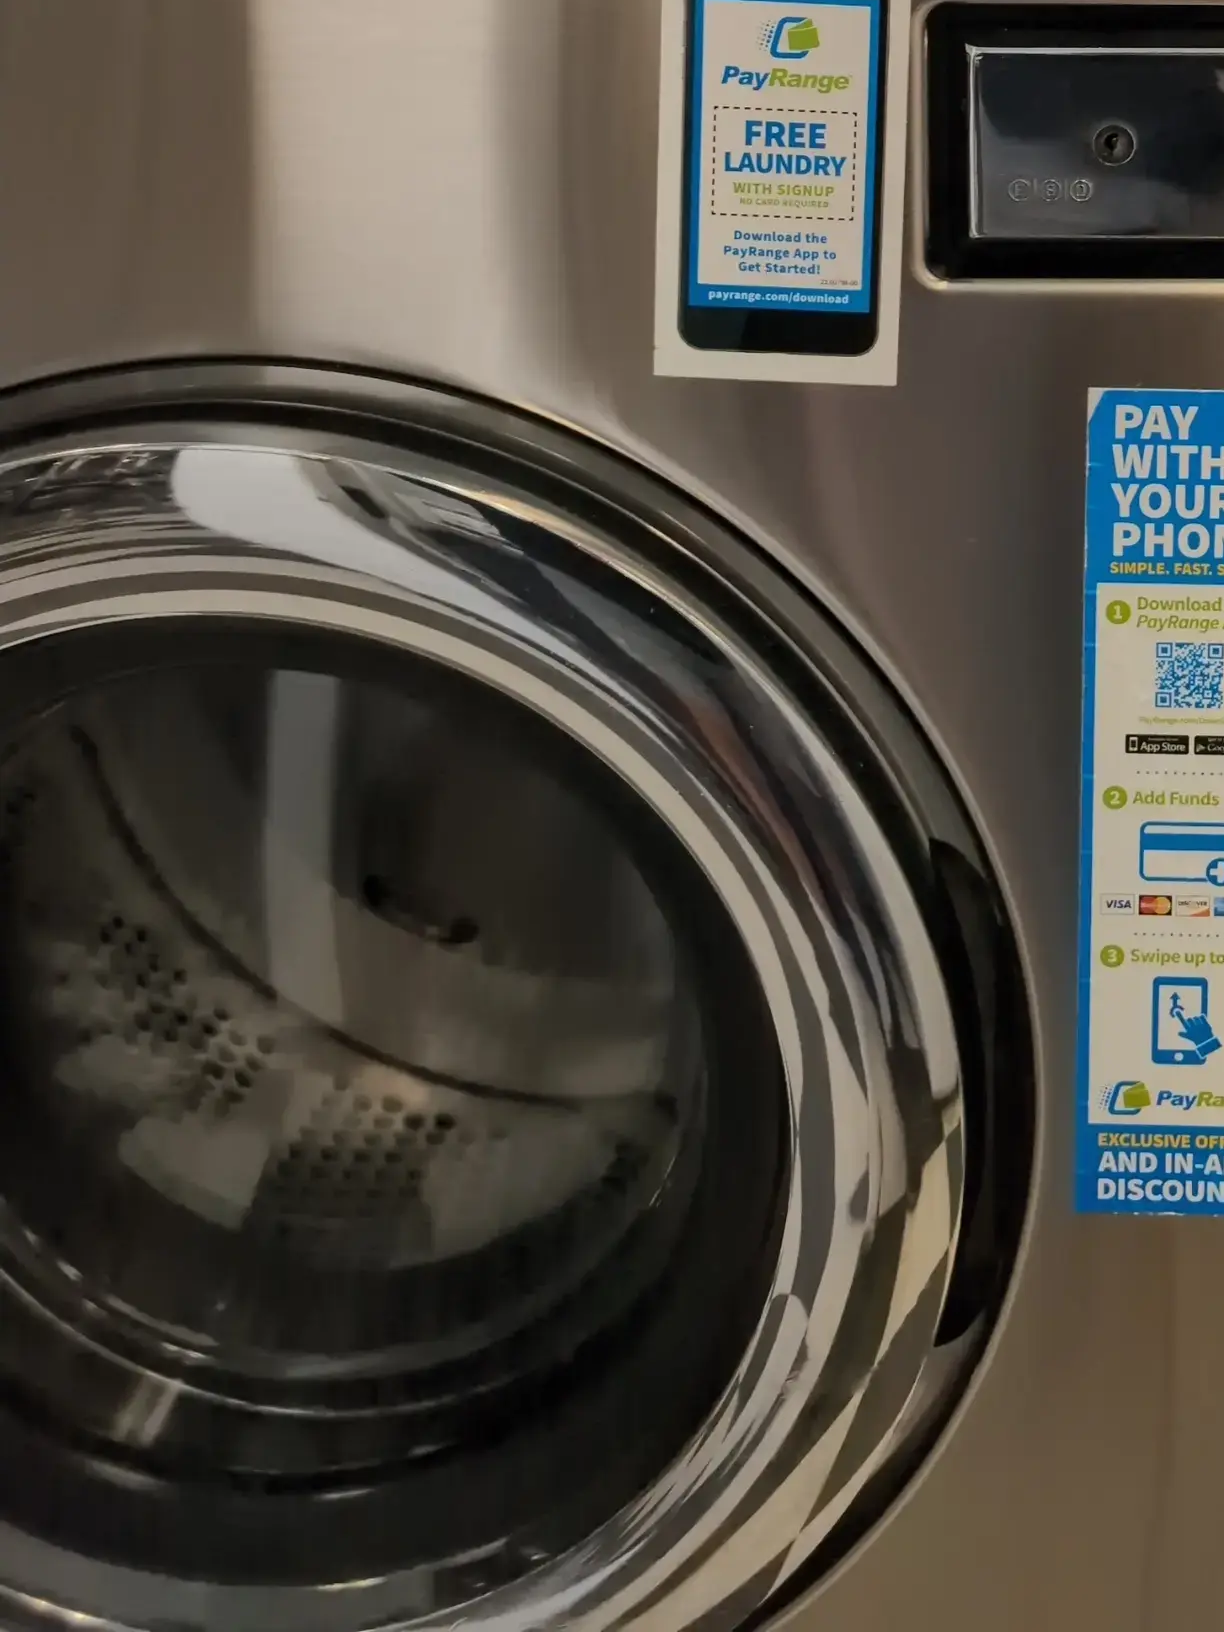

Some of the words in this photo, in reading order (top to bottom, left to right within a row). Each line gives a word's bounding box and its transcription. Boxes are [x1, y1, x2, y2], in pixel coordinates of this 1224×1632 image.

[721, 66, 851, 93] PayRange
[744, 121, 826, 149] FREE
[724, 152, 846, 179] LAUNDRY
[733, 182, 772, 195] WITH
[777, 184, 834, 197] SIGNUP
[734, 230, 801, 242] Download
[806, 232, 827, 243] the
[724, 246, 789, 260] PayRange
[793, 249, 819, 261] App
[824, 250, 836, 260] to
[738, 262, 760, 272] Get
[765, 263, 820, 274] Started!
[708, 290, 849, 304] payrange.com/download
[1114, 404, 1199, 440] PAY
[1110, 561, 1170, 575] SIMPLE.
[1174, 563, 1213, 576] FAST.
[1137, 597, 1223, 613] Download
[1136, 615, 1219, 632] PayRange
[1133, 791, 1166, 806] Add
[1170, 791, 1220, 806] Funds
[1106, 900, 1132, 909] VISA
[1131, 948, 1181, 966] Swipe
[1185, 952, 1206, 967] up
[1098, 1133, 1190, 1149] EXCLUSIVE
[1098, 1151, 1157, 1174] AND
